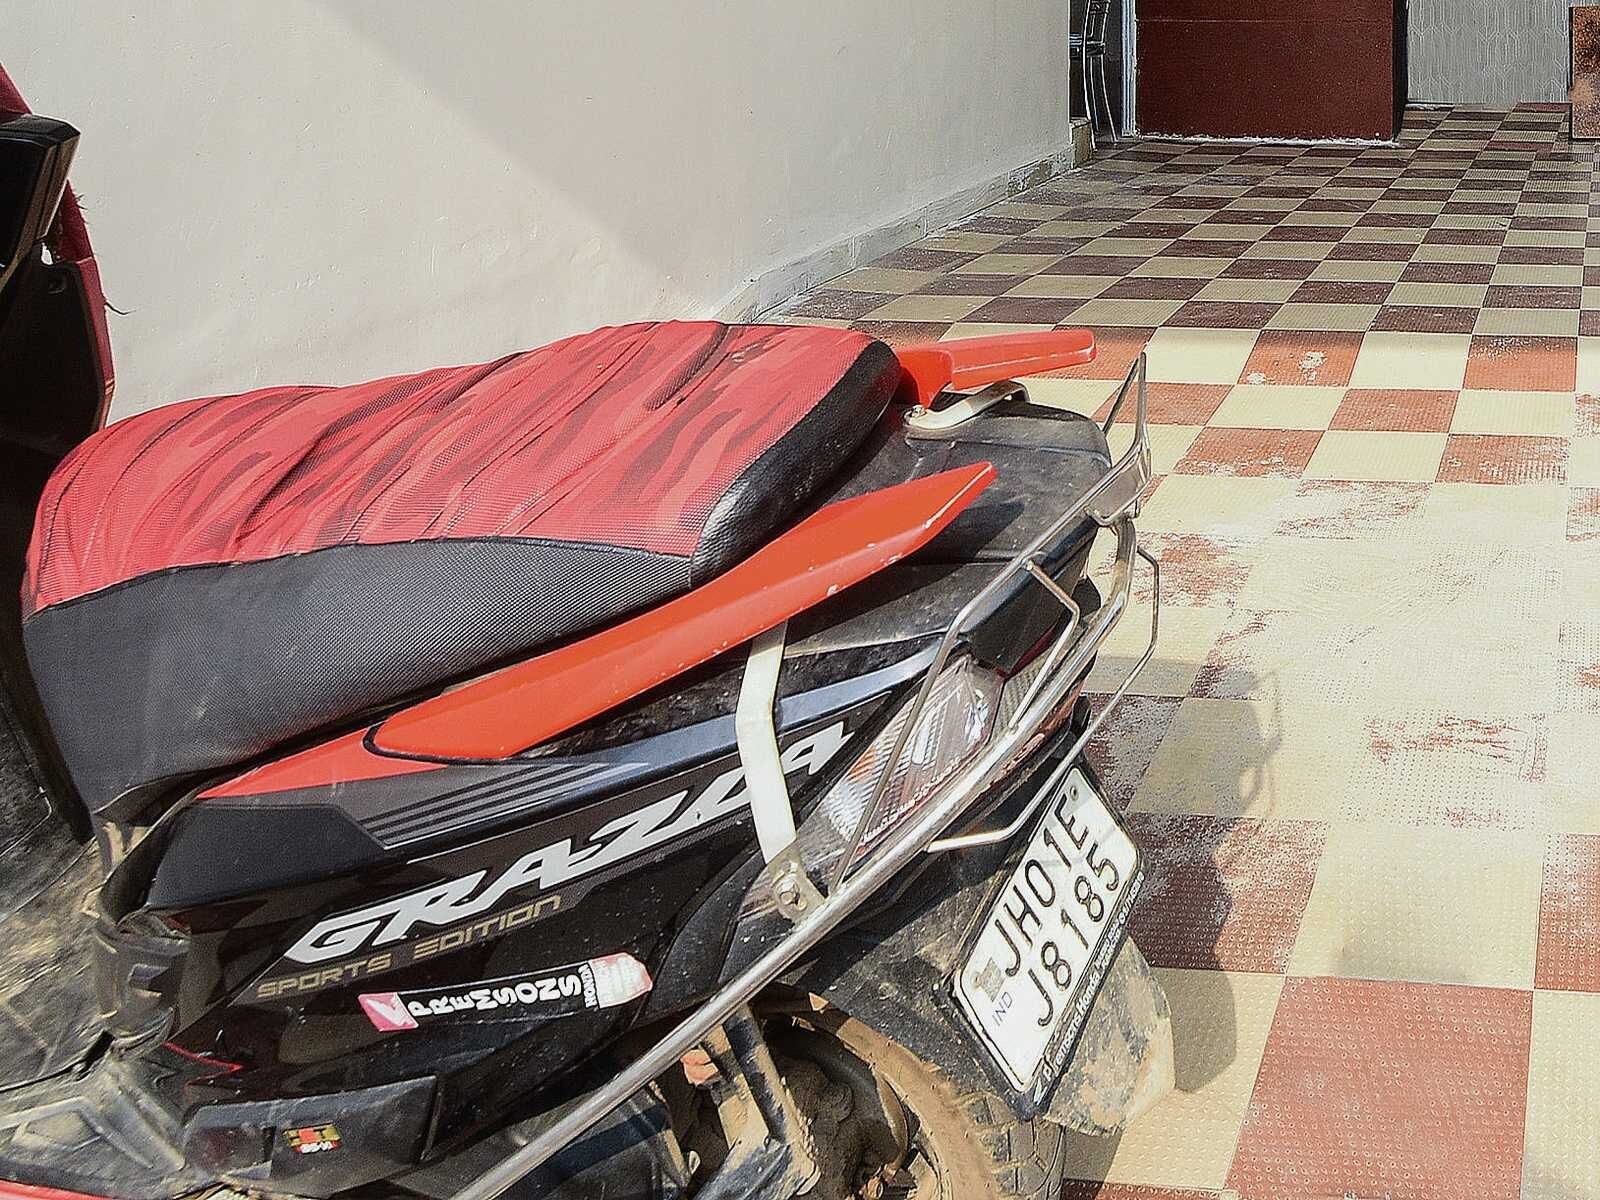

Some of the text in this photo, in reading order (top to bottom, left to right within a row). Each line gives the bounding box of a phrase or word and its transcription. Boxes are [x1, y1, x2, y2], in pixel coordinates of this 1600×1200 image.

[1005, 793, 1088, 977] JH01E
[257, 895, 562, 999] SPORTS EDITION
[1028, 843, 1120, 1028] J8185
[407, 974, 583, 1017] PREMSONS
[992, 991, 1013, 1026] IND
[1075, 968, 1102, 1017] Honda
